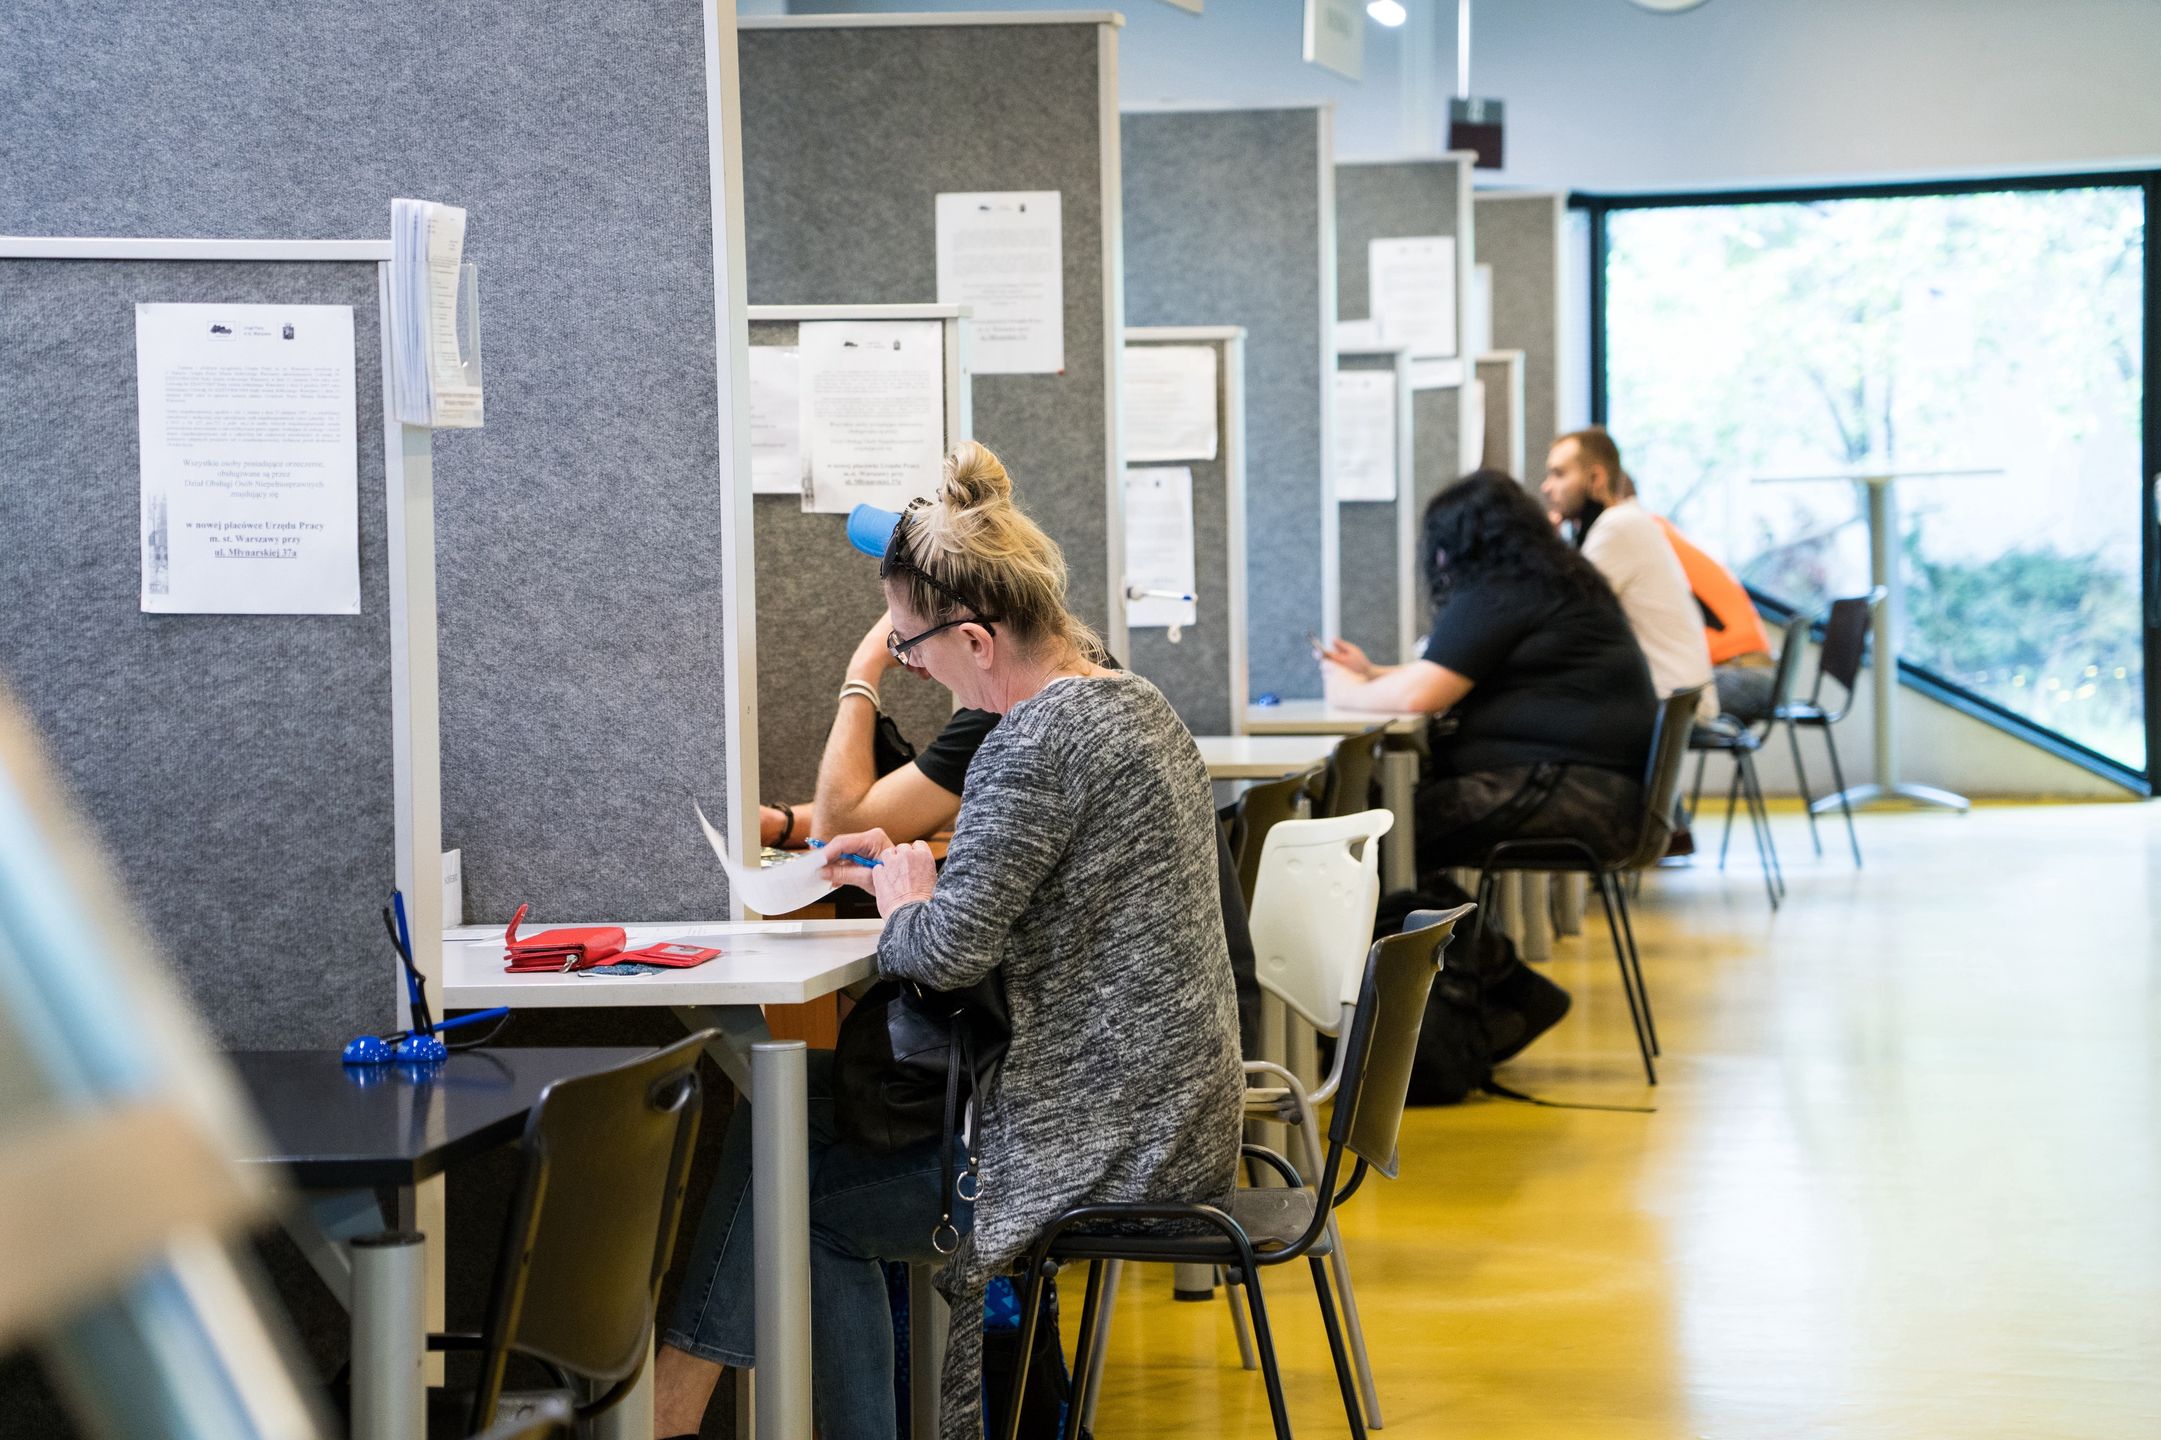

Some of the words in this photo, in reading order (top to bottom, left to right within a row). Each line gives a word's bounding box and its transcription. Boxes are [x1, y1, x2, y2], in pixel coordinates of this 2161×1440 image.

[183, 459, 219, 469] Wszystkie
[221, 460, 242, 469] osoby
[217, 470, 261, 479] obsługiwane
[184, 480, 204, 488] Dział
[205, 480, 233, 489] Obsługi
[235, 480, 253, 488] Osób
[254, 480, 325, 489] Niepełnosprawnych
[230, 490, 267, 499] znajdujący
[269, 491, 280, 499] się
[185, 521, 193, 529] w
[195, 521, 222, 531] nowej
[224, 520, 263, 531] placówce
[265, 521, 297, 531] Urzędu
[299, 521, 325, 532] Pracy
[209, 535, 220, 543] m.
[222, 535, 233, 543] st.
[235, 534, 280, 545] Warszawy
[282, 536, 301, 545] przy
[214, 548, 225, 557] ul.
[228, 548, 280, 558] Młynarskiej
[282, 548, 297, 558] 37a
